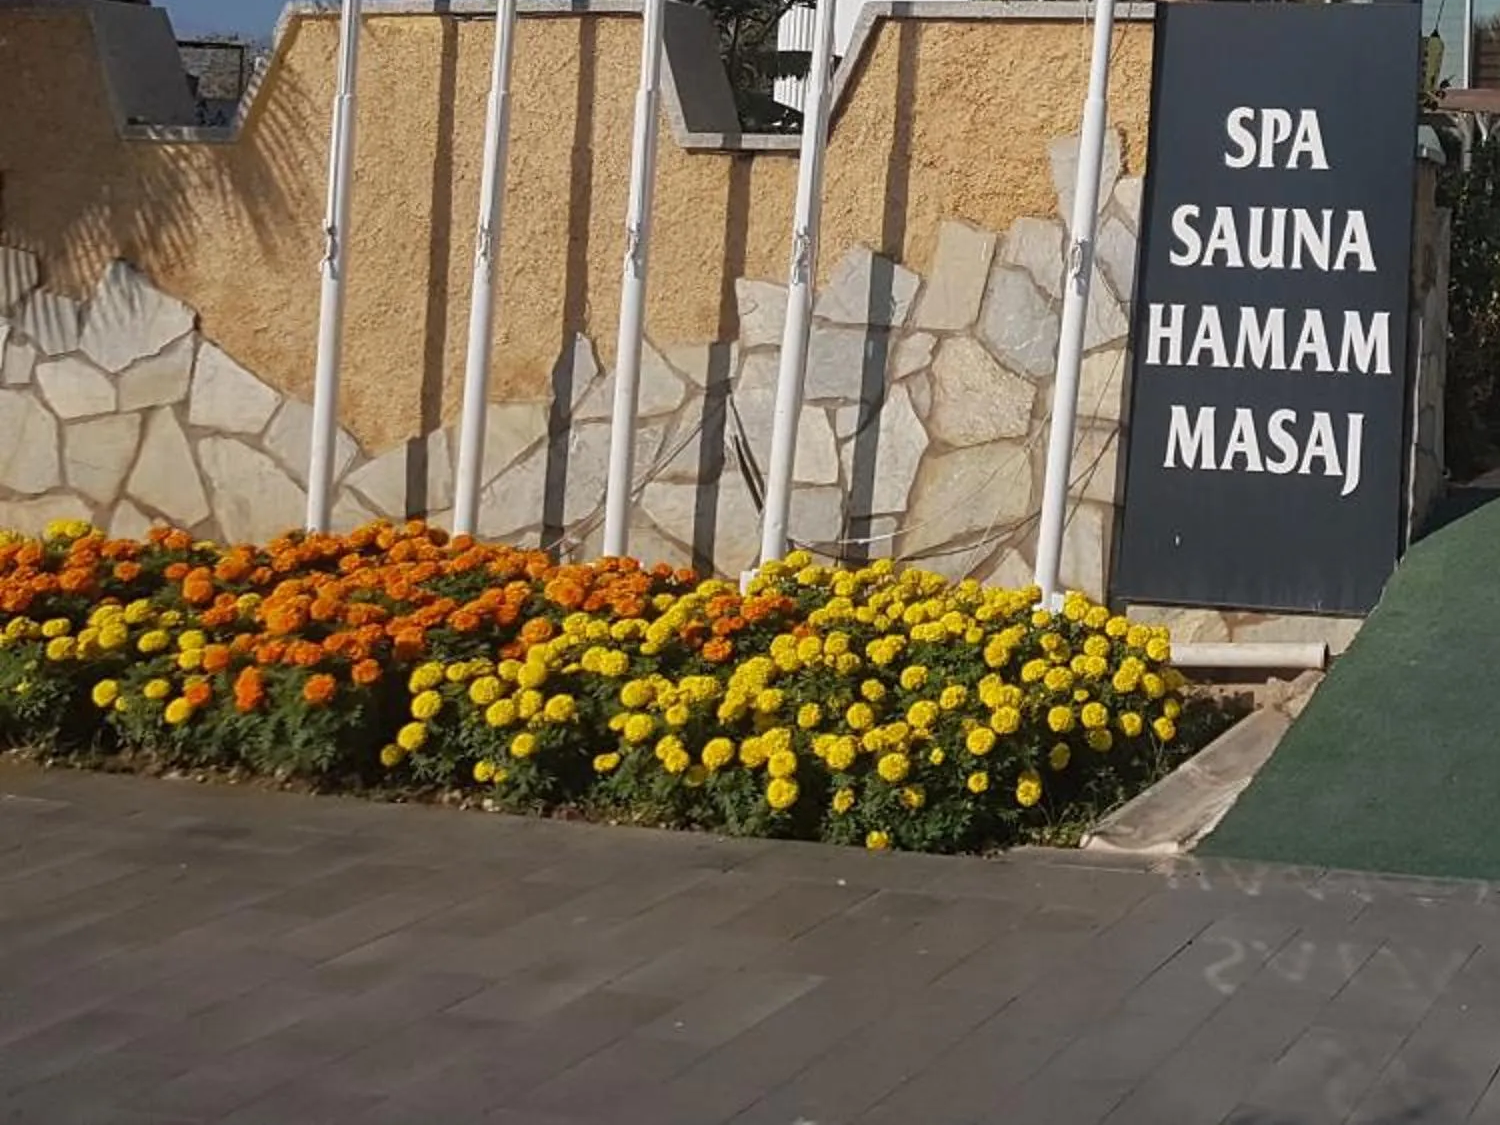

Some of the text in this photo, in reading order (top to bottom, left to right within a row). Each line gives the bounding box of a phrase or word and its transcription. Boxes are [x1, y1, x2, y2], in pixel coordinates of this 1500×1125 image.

[1224, 106, 1329, 170] SPA
[1169, 203, 1377, 272] SAUNA
[1145, 303, 1392, 375] HAMAM
[1163, 405, 1365, 496] MASAJ
